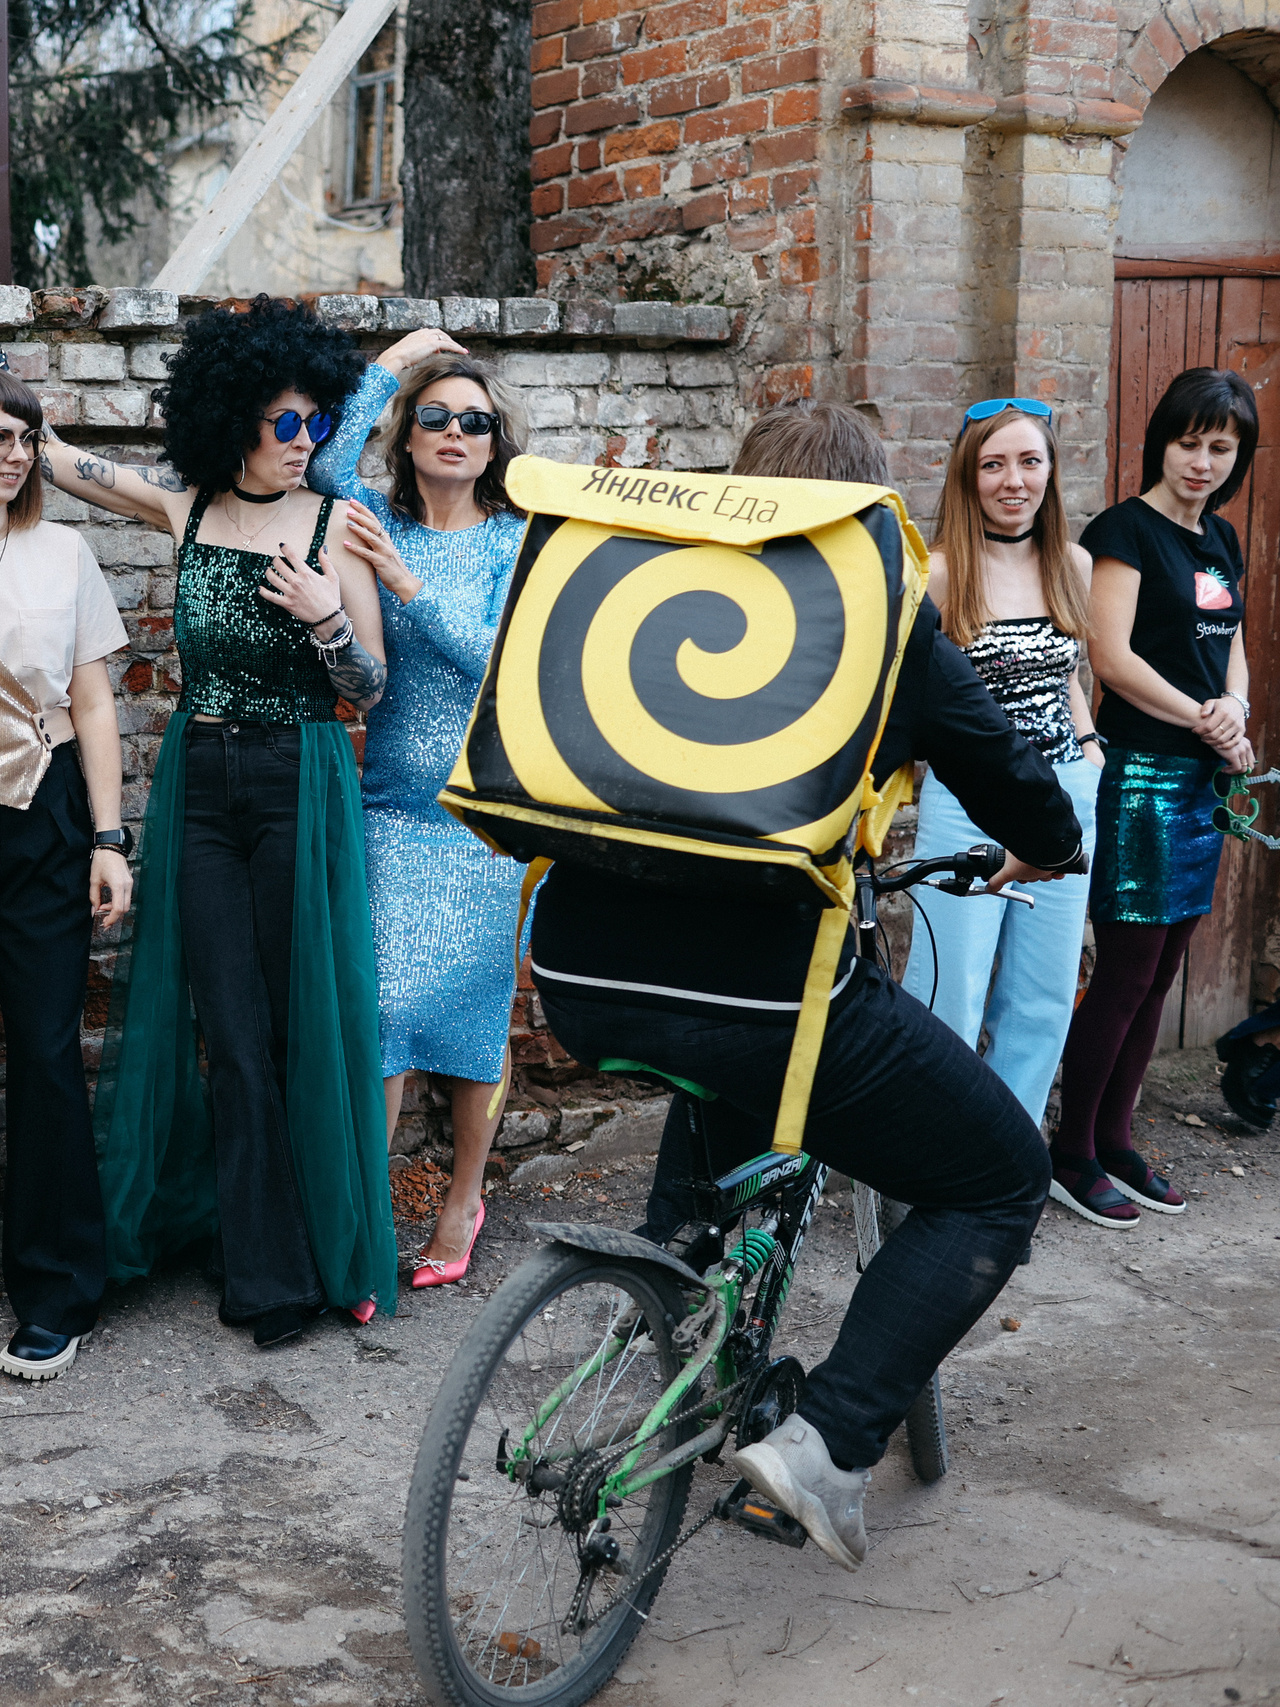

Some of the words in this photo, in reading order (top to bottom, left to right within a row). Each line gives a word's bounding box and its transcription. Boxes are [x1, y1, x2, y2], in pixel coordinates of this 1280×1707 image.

[581, 468, 708, 511] Яндекс
[713, 485, 779, 524] Еда
[760, 1157, 802, 1188] BANZAI
